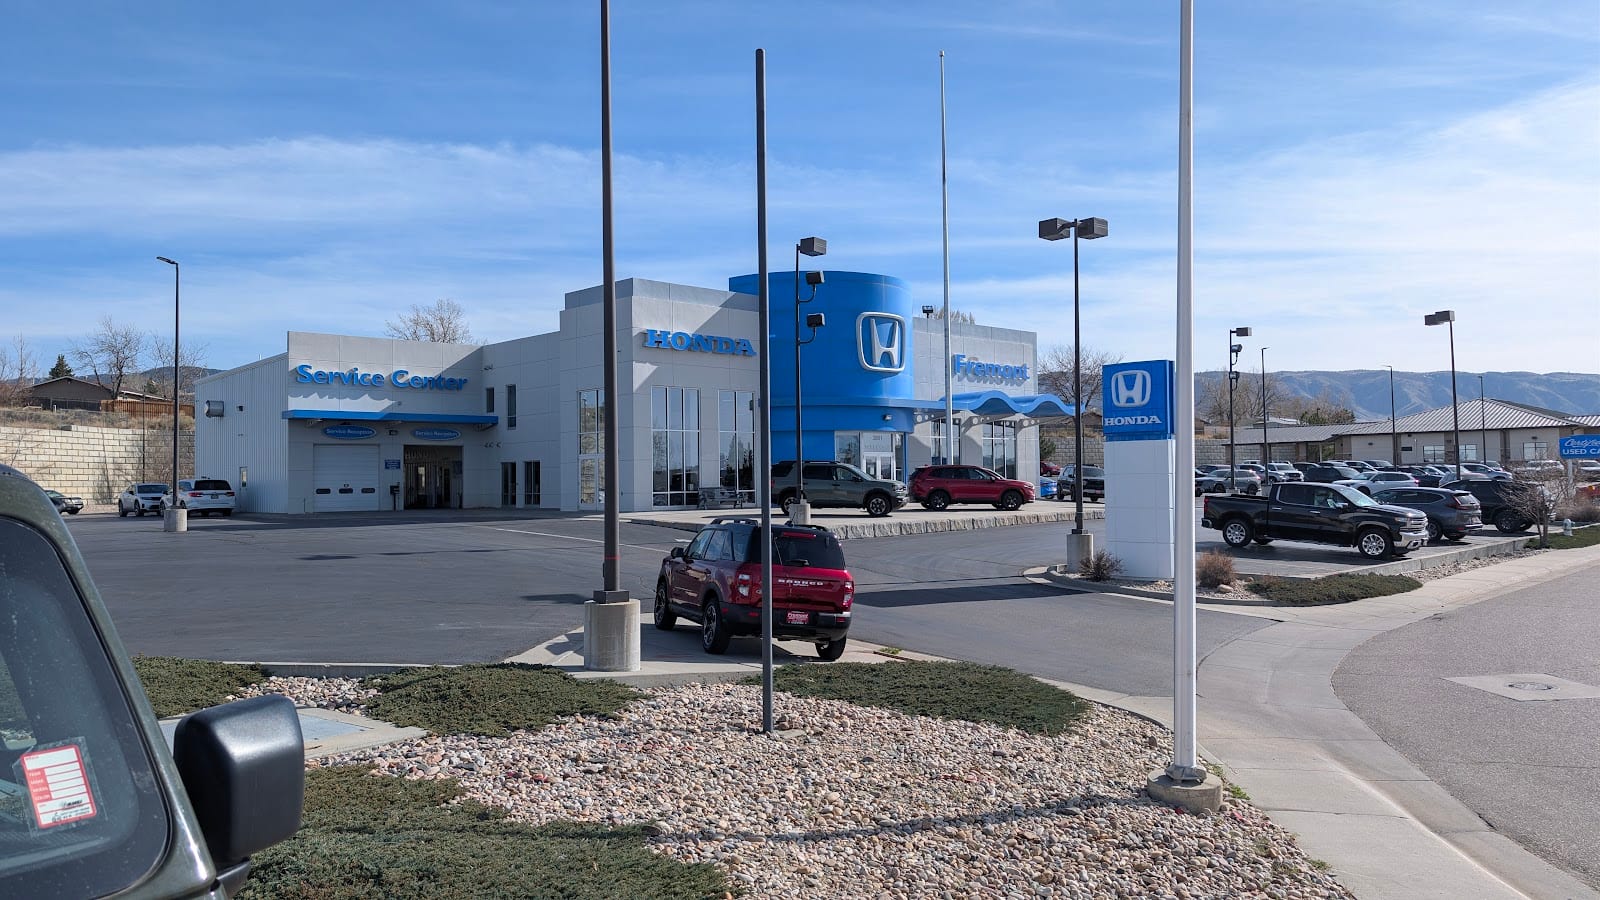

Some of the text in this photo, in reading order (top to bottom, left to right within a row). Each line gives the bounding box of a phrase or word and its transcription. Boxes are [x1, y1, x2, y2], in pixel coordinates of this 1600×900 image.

[645, 328, 758, 357] HONDA
[296, 363, 468, 391] Service Center
[953, 353, 1030, 380] Fremont
[1103, 415, 1162, 427] HONDA
